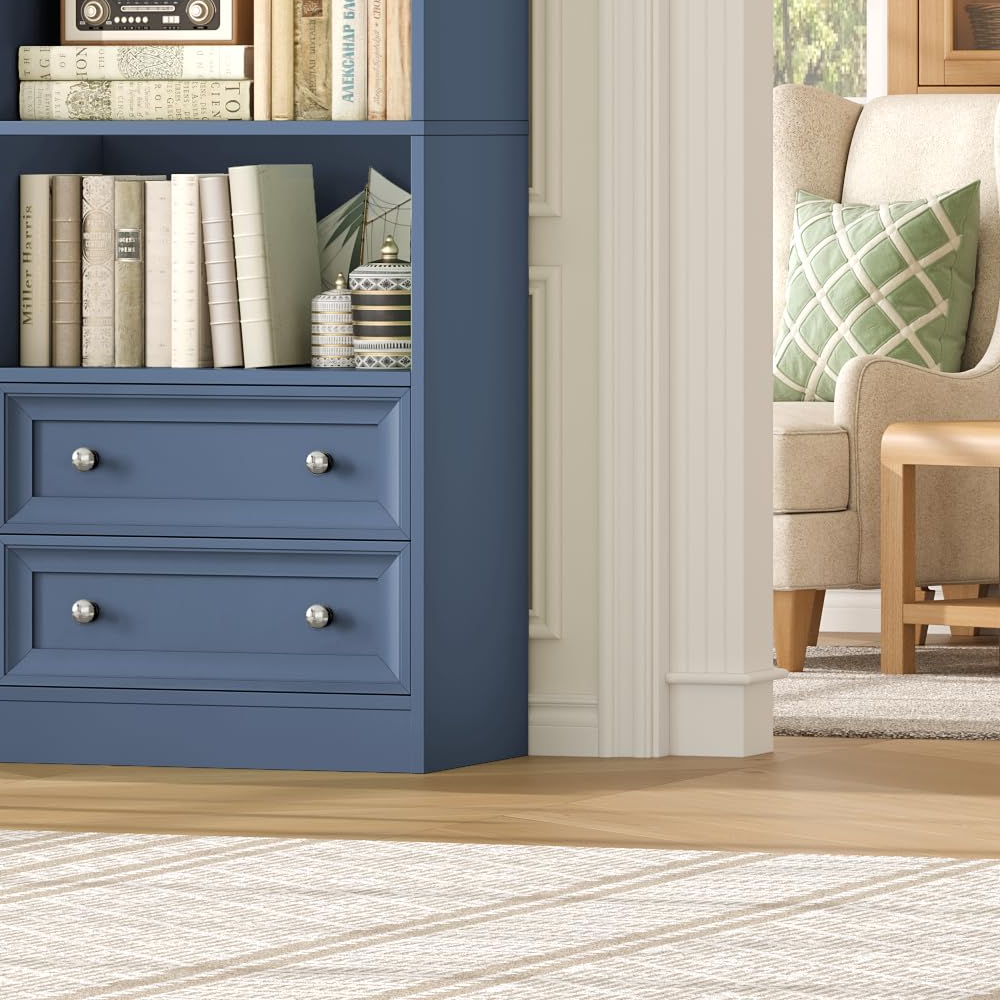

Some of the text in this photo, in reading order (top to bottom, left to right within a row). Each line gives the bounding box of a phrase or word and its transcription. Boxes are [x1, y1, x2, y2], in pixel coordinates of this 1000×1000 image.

[341, 24, 355, 103] АЛЕКСАНДР
[22, 204, 33, 325] Miller Harris
